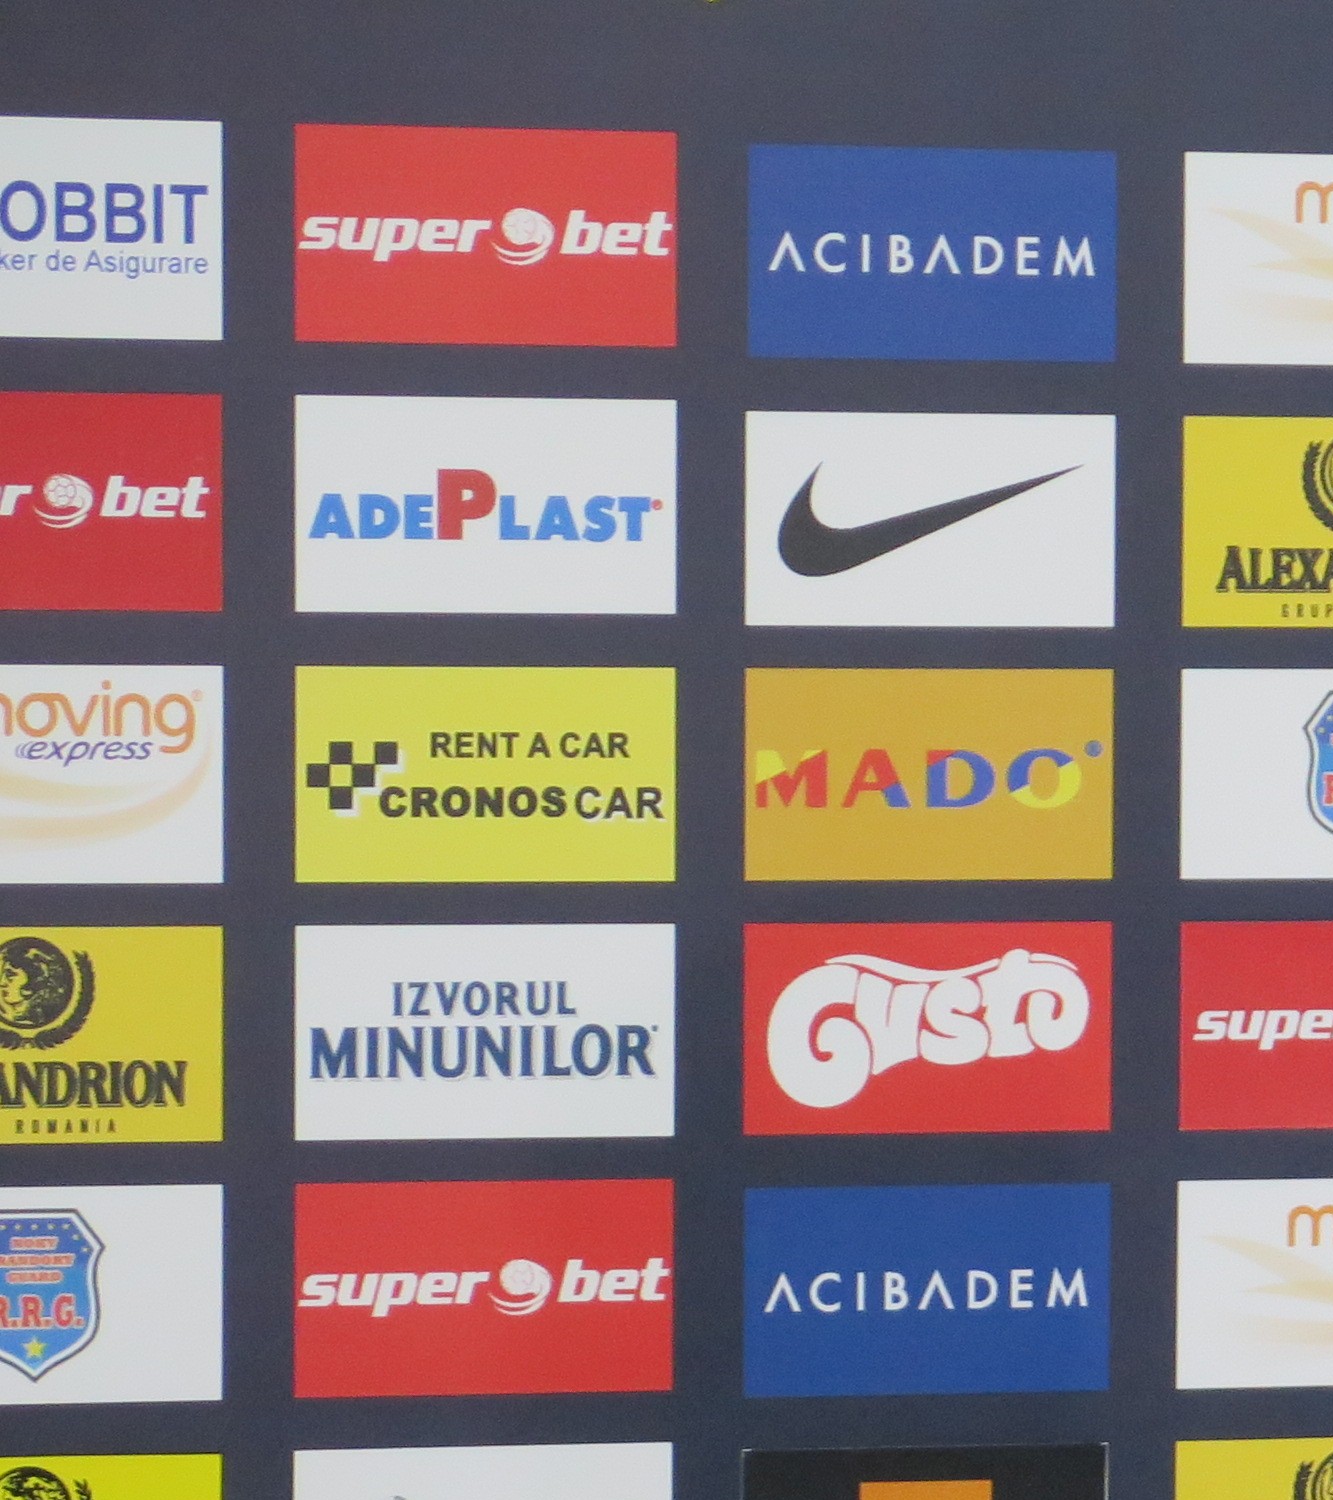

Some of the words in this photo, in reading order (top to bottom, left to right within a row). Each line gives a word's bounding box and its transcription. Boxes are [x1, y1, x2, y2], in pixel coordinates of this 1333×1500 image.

[299, 216, 493, 262] super
[560, 210, 673, 256] bet
[769, 232, 1095, 276] ACIBADEM
[47, 249, 76, 272] de
[85, 250, 208, 280] Asigurare
[100, 475, 210, 518] bet
[309, 469, 651, 542] ADEPLAST
[30, 733, 153, 765] express
[431, 732, 519, 758] RENT
[527, 732, 551, 758] A
[559, 732, 629, 758] CAR
[756, 747, 1079, 810] MADO
[380, 784, 565, 818] CRONOS
[575, 786, 663, 821] CAR
[393, 981, 577, 1016] IZVORUL
[767, 949, 1090, 1108] GUSTO
[310, 1024, 655, 1078] MINUNILOR
[298, 1271, 490, 1317] super
[558, 1258, 670, 1303] bet
[764, 1268, 1088, 1313] ACIBADEM
